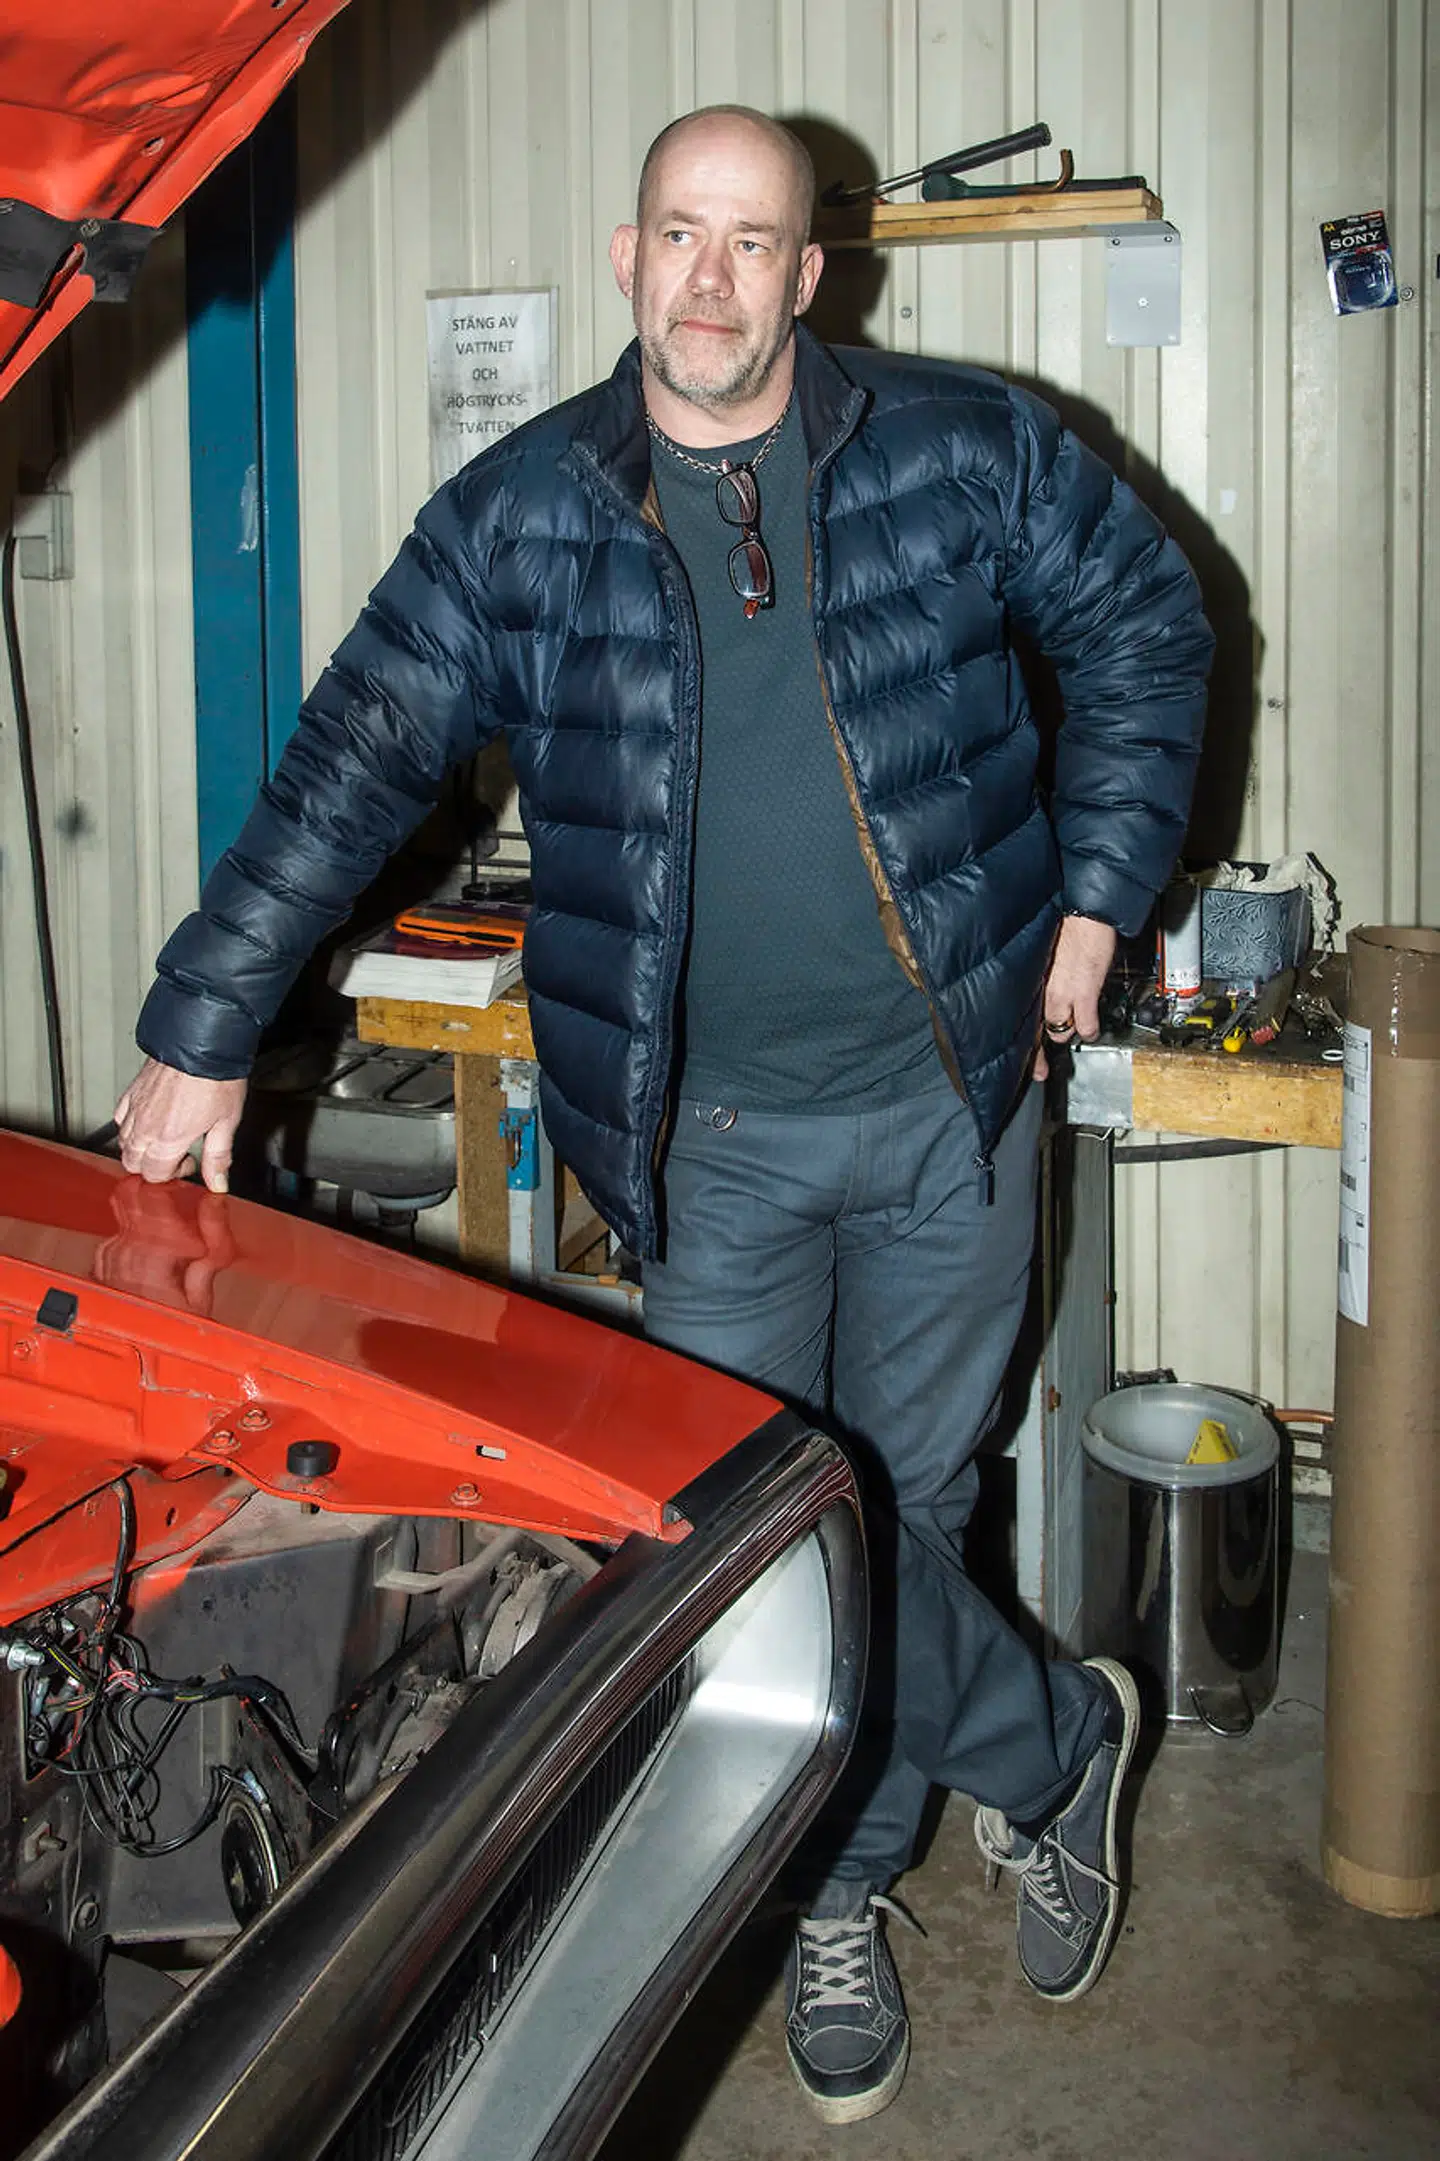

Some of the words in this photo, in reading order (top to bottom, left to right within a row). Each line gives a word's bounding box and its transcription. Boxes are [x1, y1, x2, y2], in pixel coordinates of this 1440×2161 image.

[1329, 231, 1380, 250] SONY
[452, 315, 495, 331] STÄNG
[499, 315, 518, 329] AV
[456, 340, 514, 355] VATTNET
[472, 368, 498, 381] OCH
